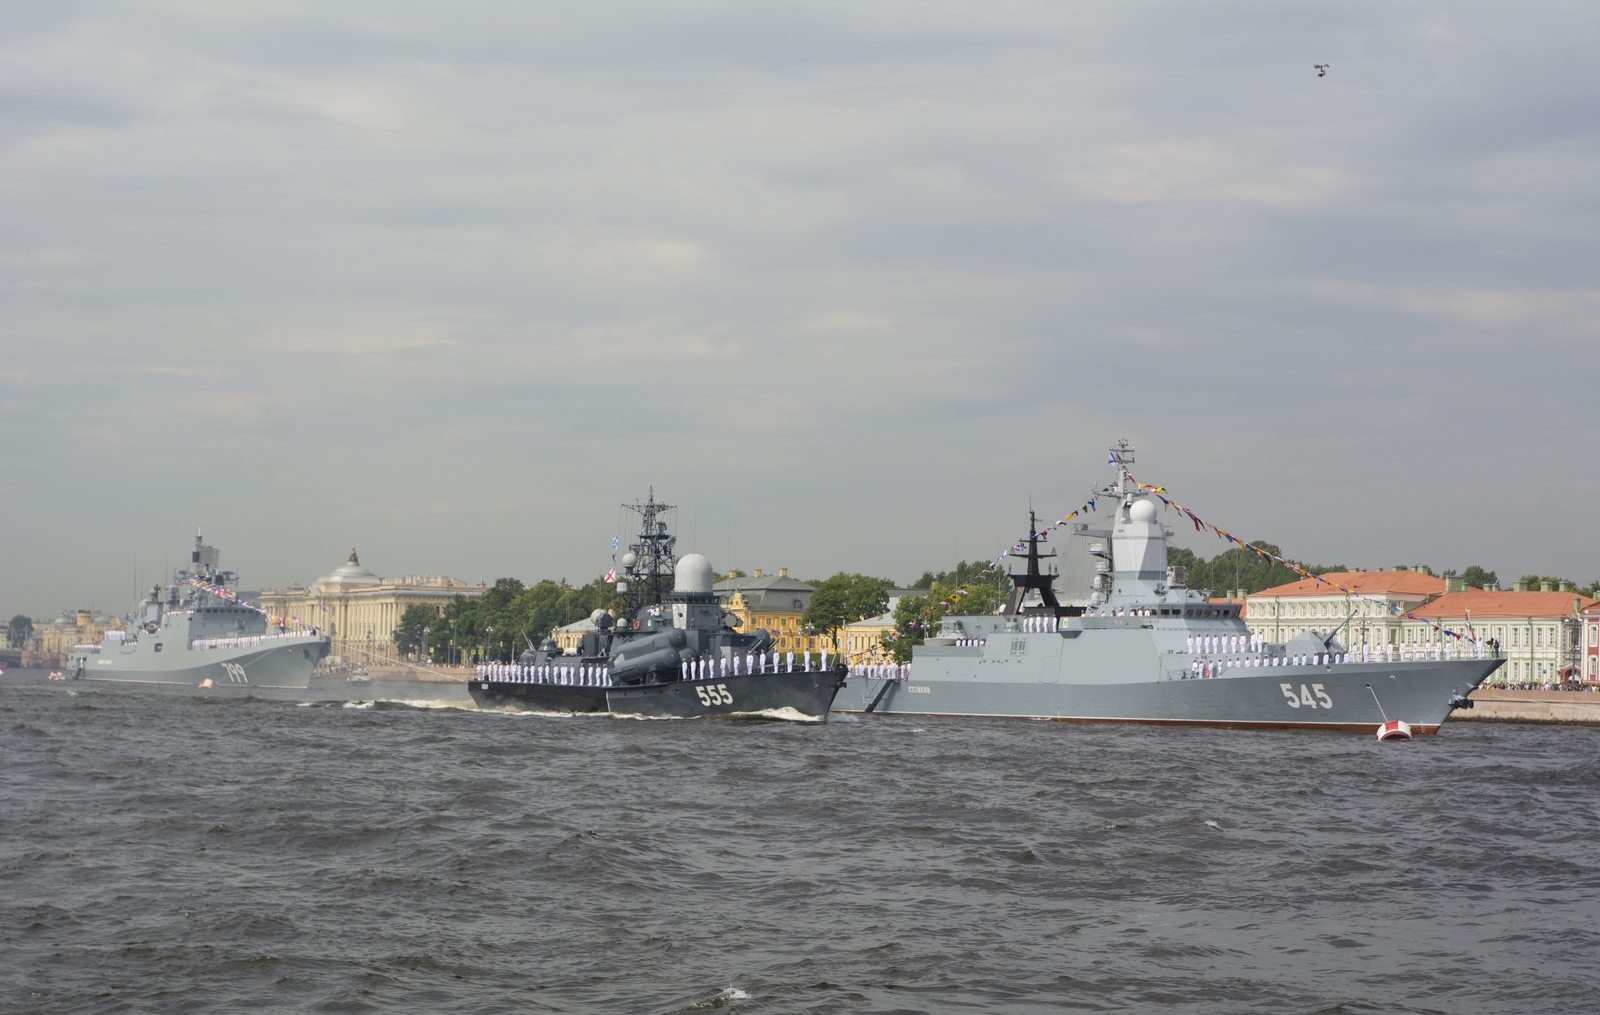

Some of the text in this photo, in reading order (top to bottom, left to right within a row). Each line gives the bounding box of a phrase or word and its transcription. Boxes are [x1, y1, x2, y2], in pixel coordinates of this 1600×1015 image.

[220, 662, 248, 684] 799
[695, 683, 733, 706] 555
[1279, 683, 1333, 709] 545
